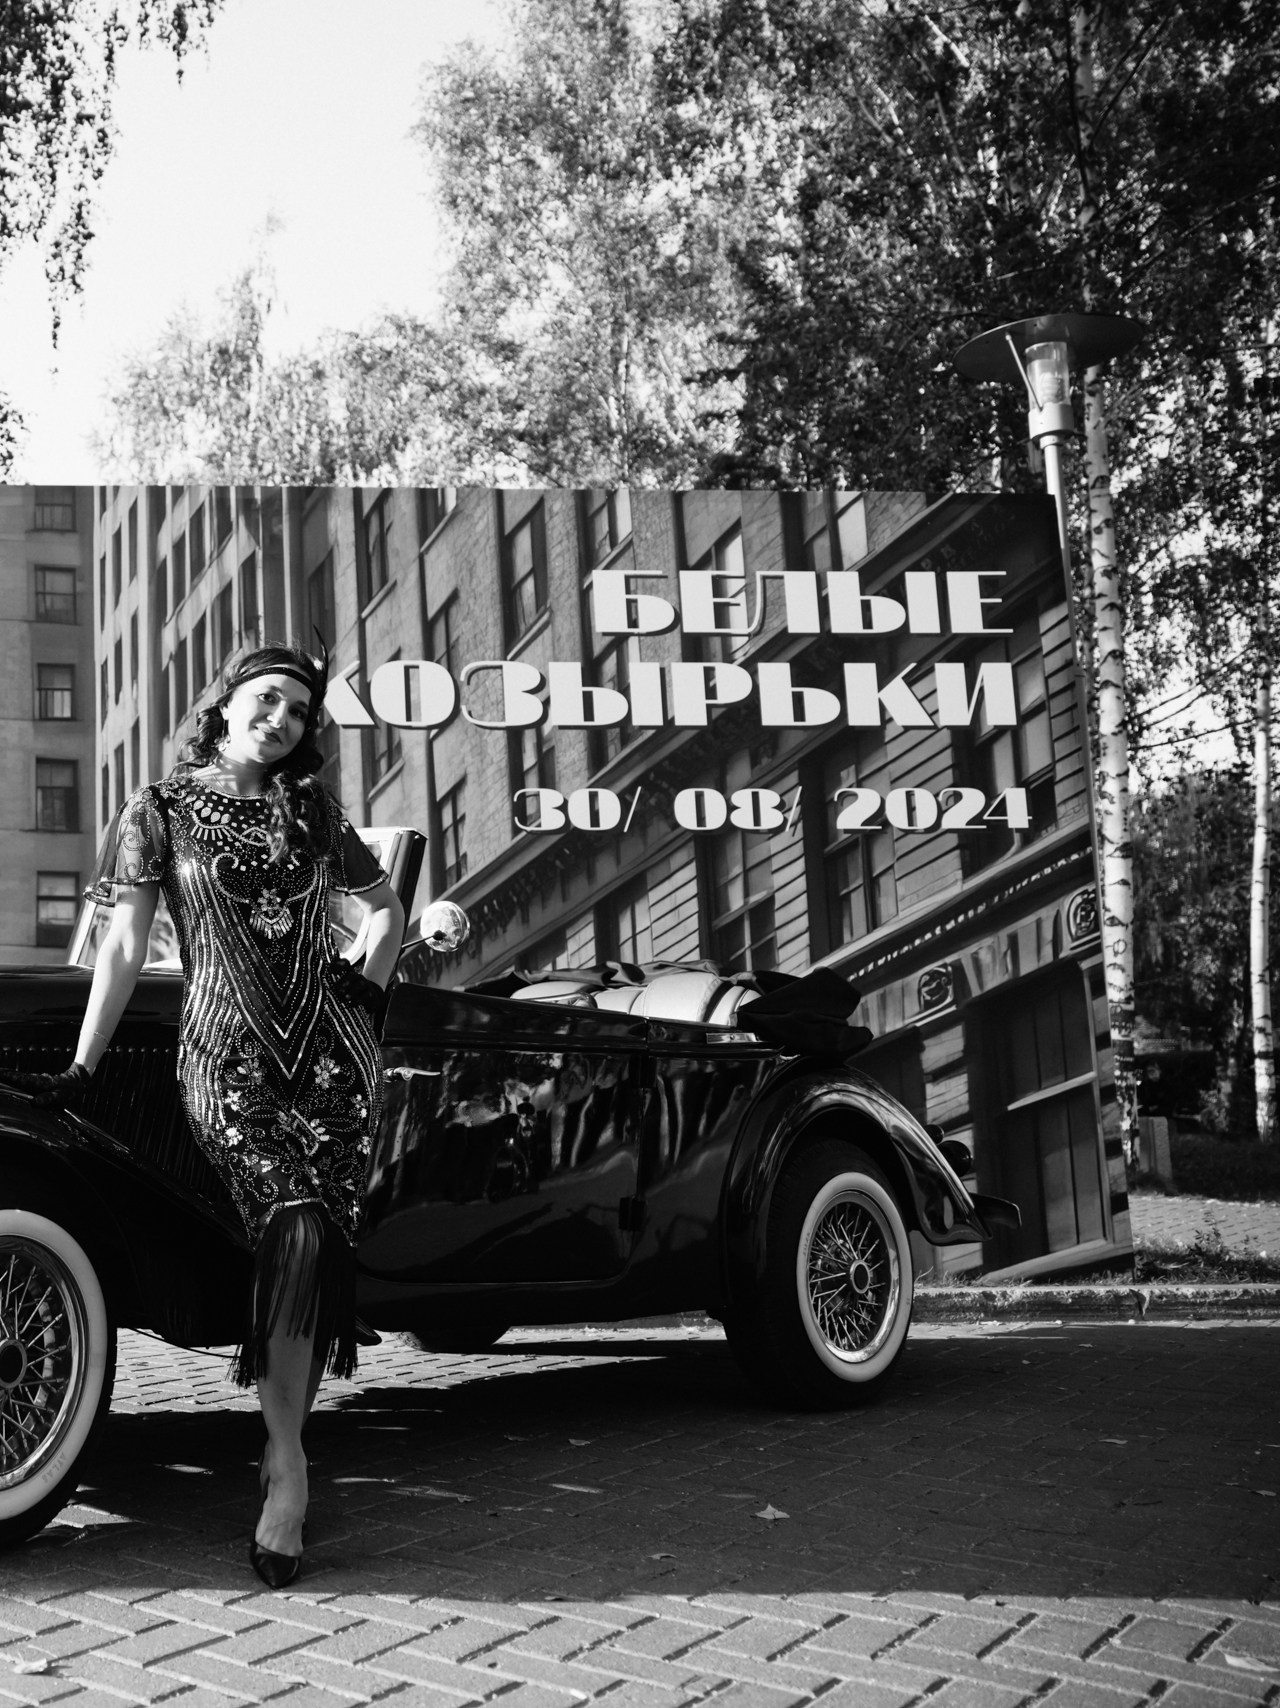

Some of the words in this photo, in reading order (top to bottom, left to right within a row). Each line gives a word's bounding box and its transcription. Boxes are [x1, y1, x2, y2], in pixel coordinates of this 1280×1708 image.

[592, 569, 1014, 634] БЕЛЫЕ
[514, 786, 641, 832] 30/
[674, 786, 802, 832] 08/
[834, 787, 1032, 829] 2024
